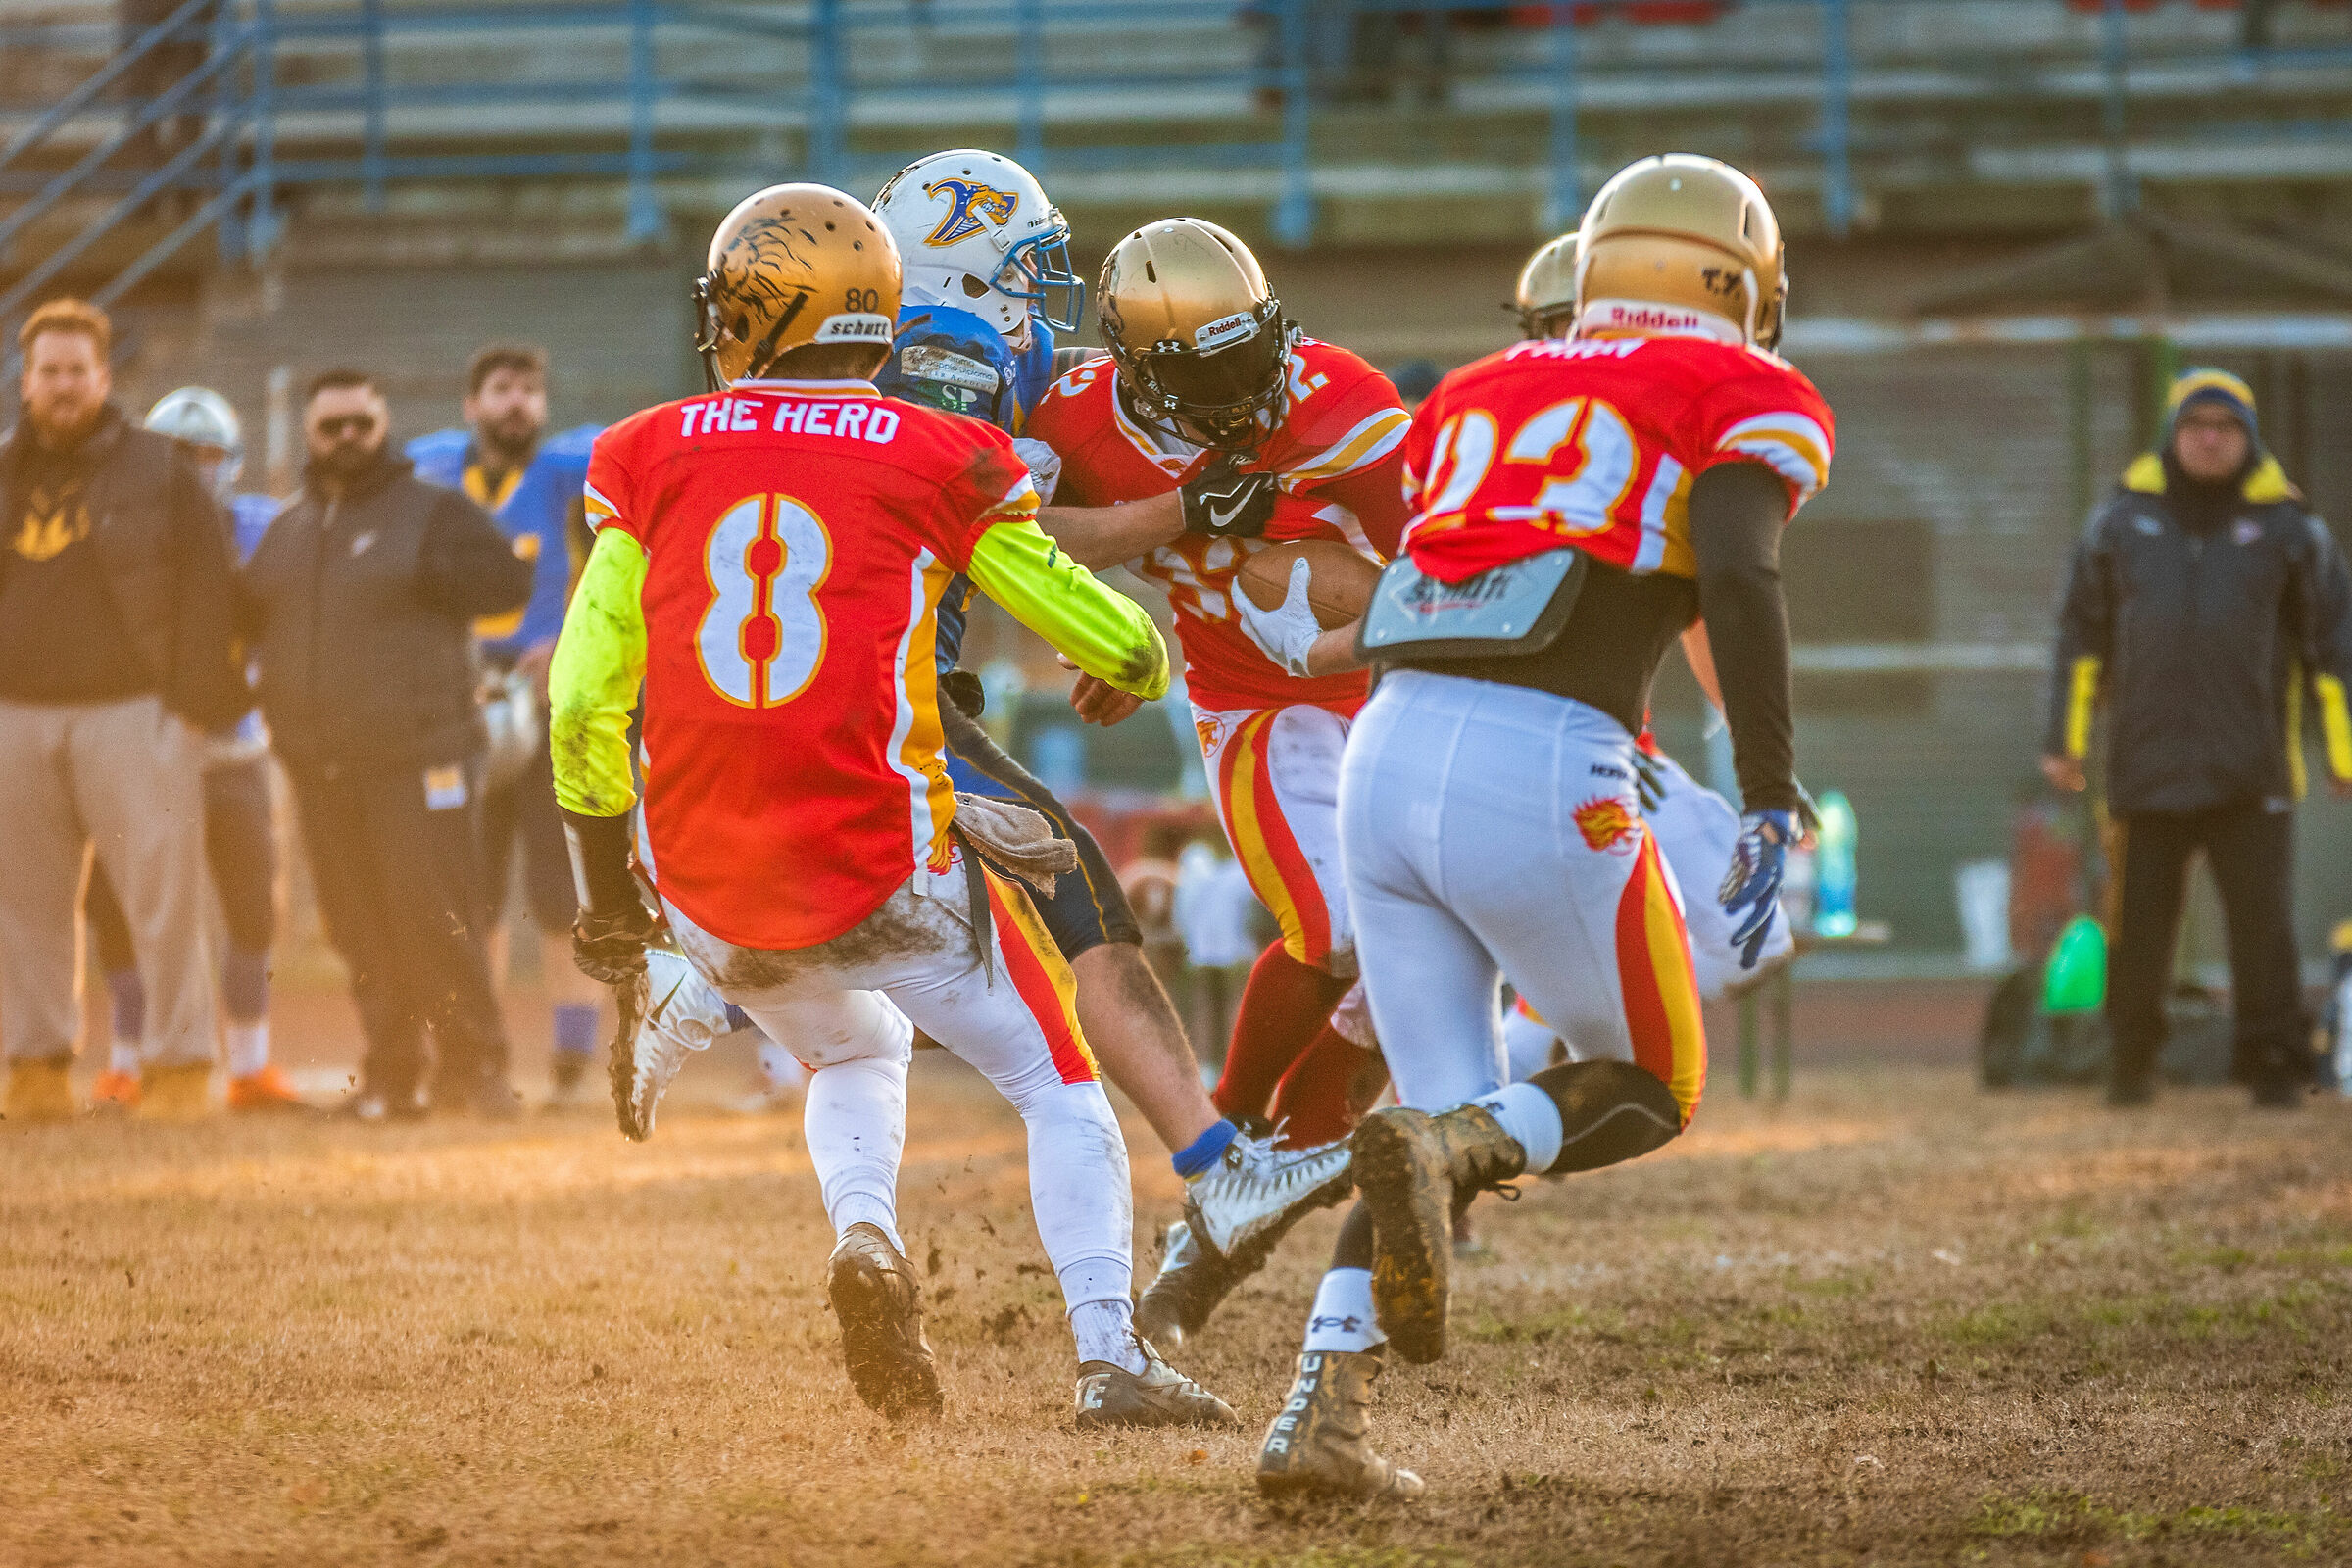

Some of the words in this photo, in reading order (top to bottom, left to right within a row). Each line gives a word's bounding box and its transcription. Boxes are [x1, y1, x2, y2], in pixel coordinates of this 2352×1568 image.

[845, 287, 879, 313] 80
[1612, 306, 1699, 329] Riddell
[1208, 317, 1242, 337] Riddell
[680, 397, 763, 438] THE
[772, 403, 901, 445] HERD
[694, 492, 833, 710] 8
[1267, 1355, 1323, 1454] UNDER
